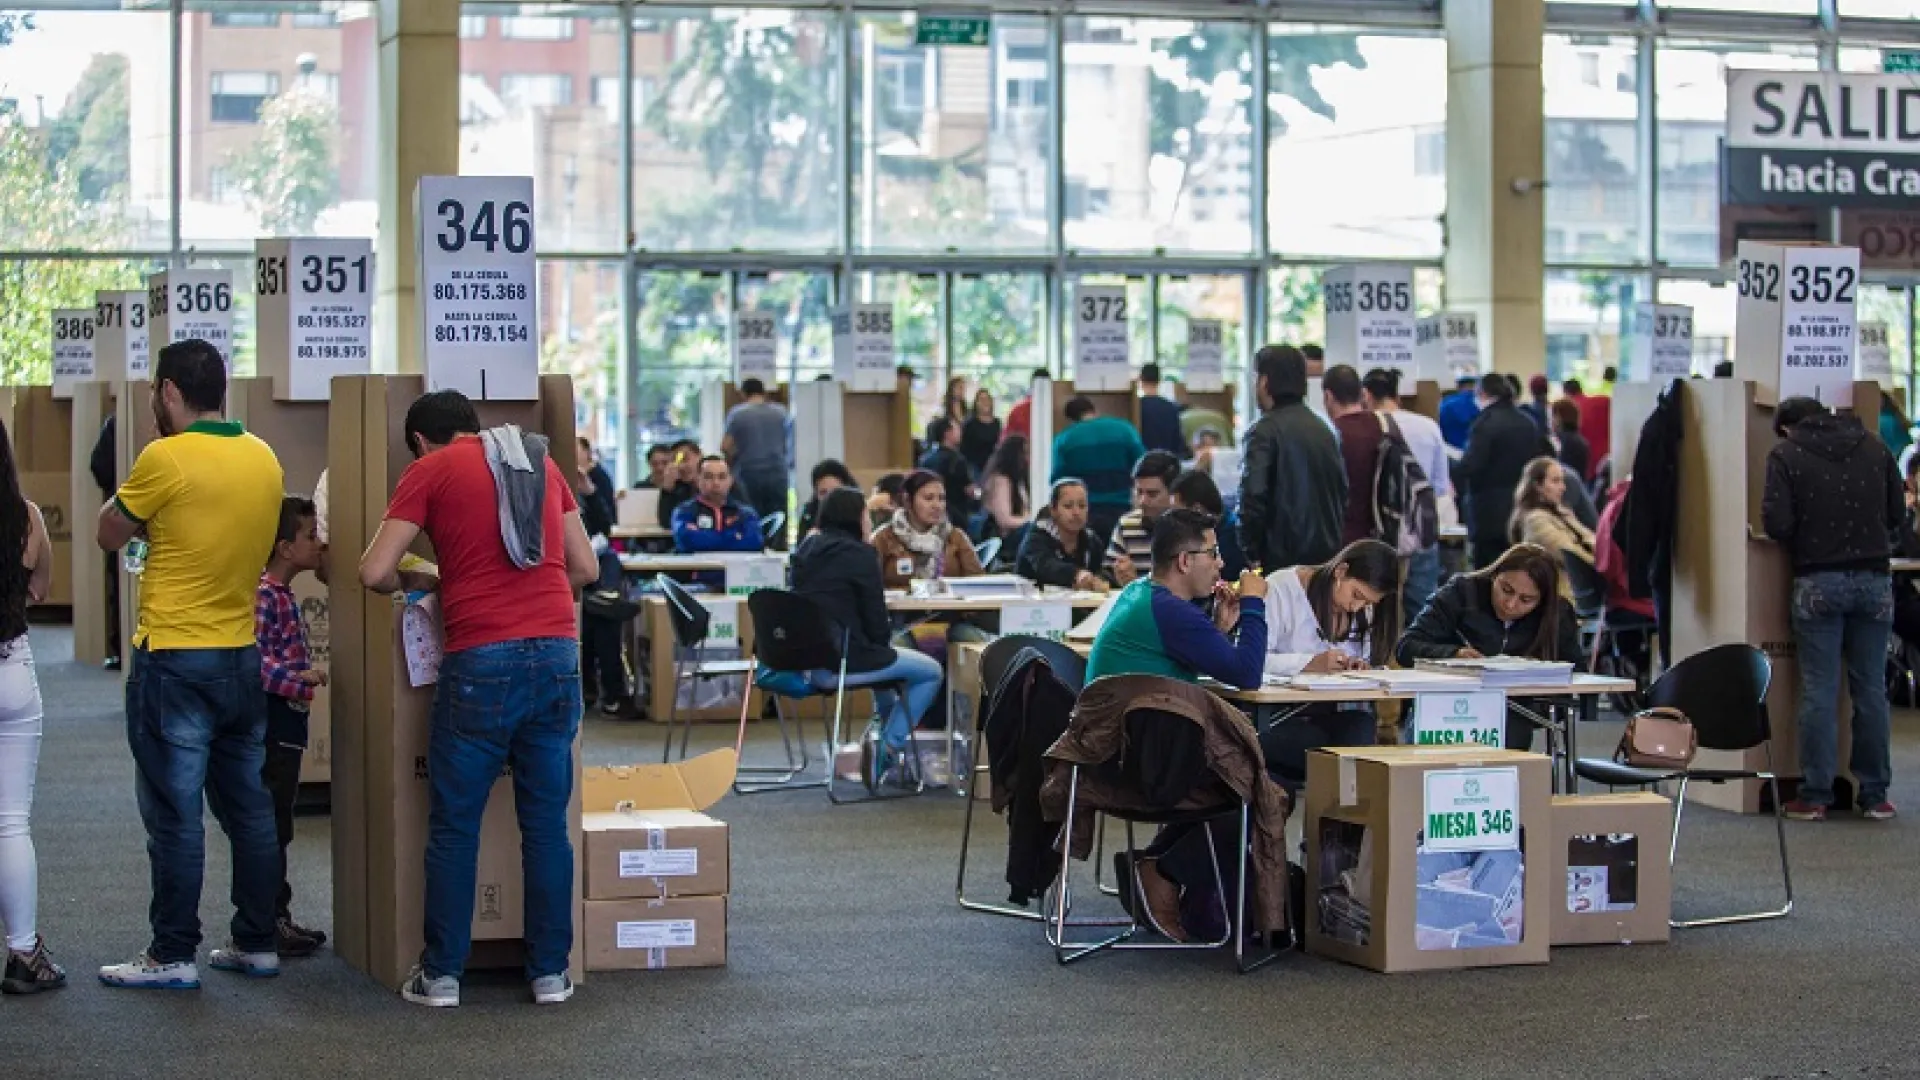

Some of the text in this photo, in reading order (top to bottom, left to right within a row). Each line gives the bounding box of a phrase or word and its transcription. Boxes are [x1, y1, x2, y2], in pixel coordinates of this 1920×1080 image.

[1761, 154, 1856, 192] hacia
[437, 199, 530, 253] 346
[257, 256, 288, 295] 351
[302, 255, 367, 293] 351
[1738, 260, 1780, 301] 352
[1790, 266, 1855, 302] 352
[176, 282, 232, 313] 366
[434, 283, 527, 300] 80.175.368
[1357, 280, 1409, 312] 365
[96, 302, 123, 328] 371
[297, 315, 367, 328] 80.195.527
[856, 310, 893, 334] 385
[1082, 296, 1126, 322] 372
[56, 317, 94, 340] 386
[435, 325, 527, 342] 80.179.154
[1655, 314, 1693, 340] 373
[297, 345, 367, 359] 80.198.975
[1429, 809, 1513, 839] MESA 346
